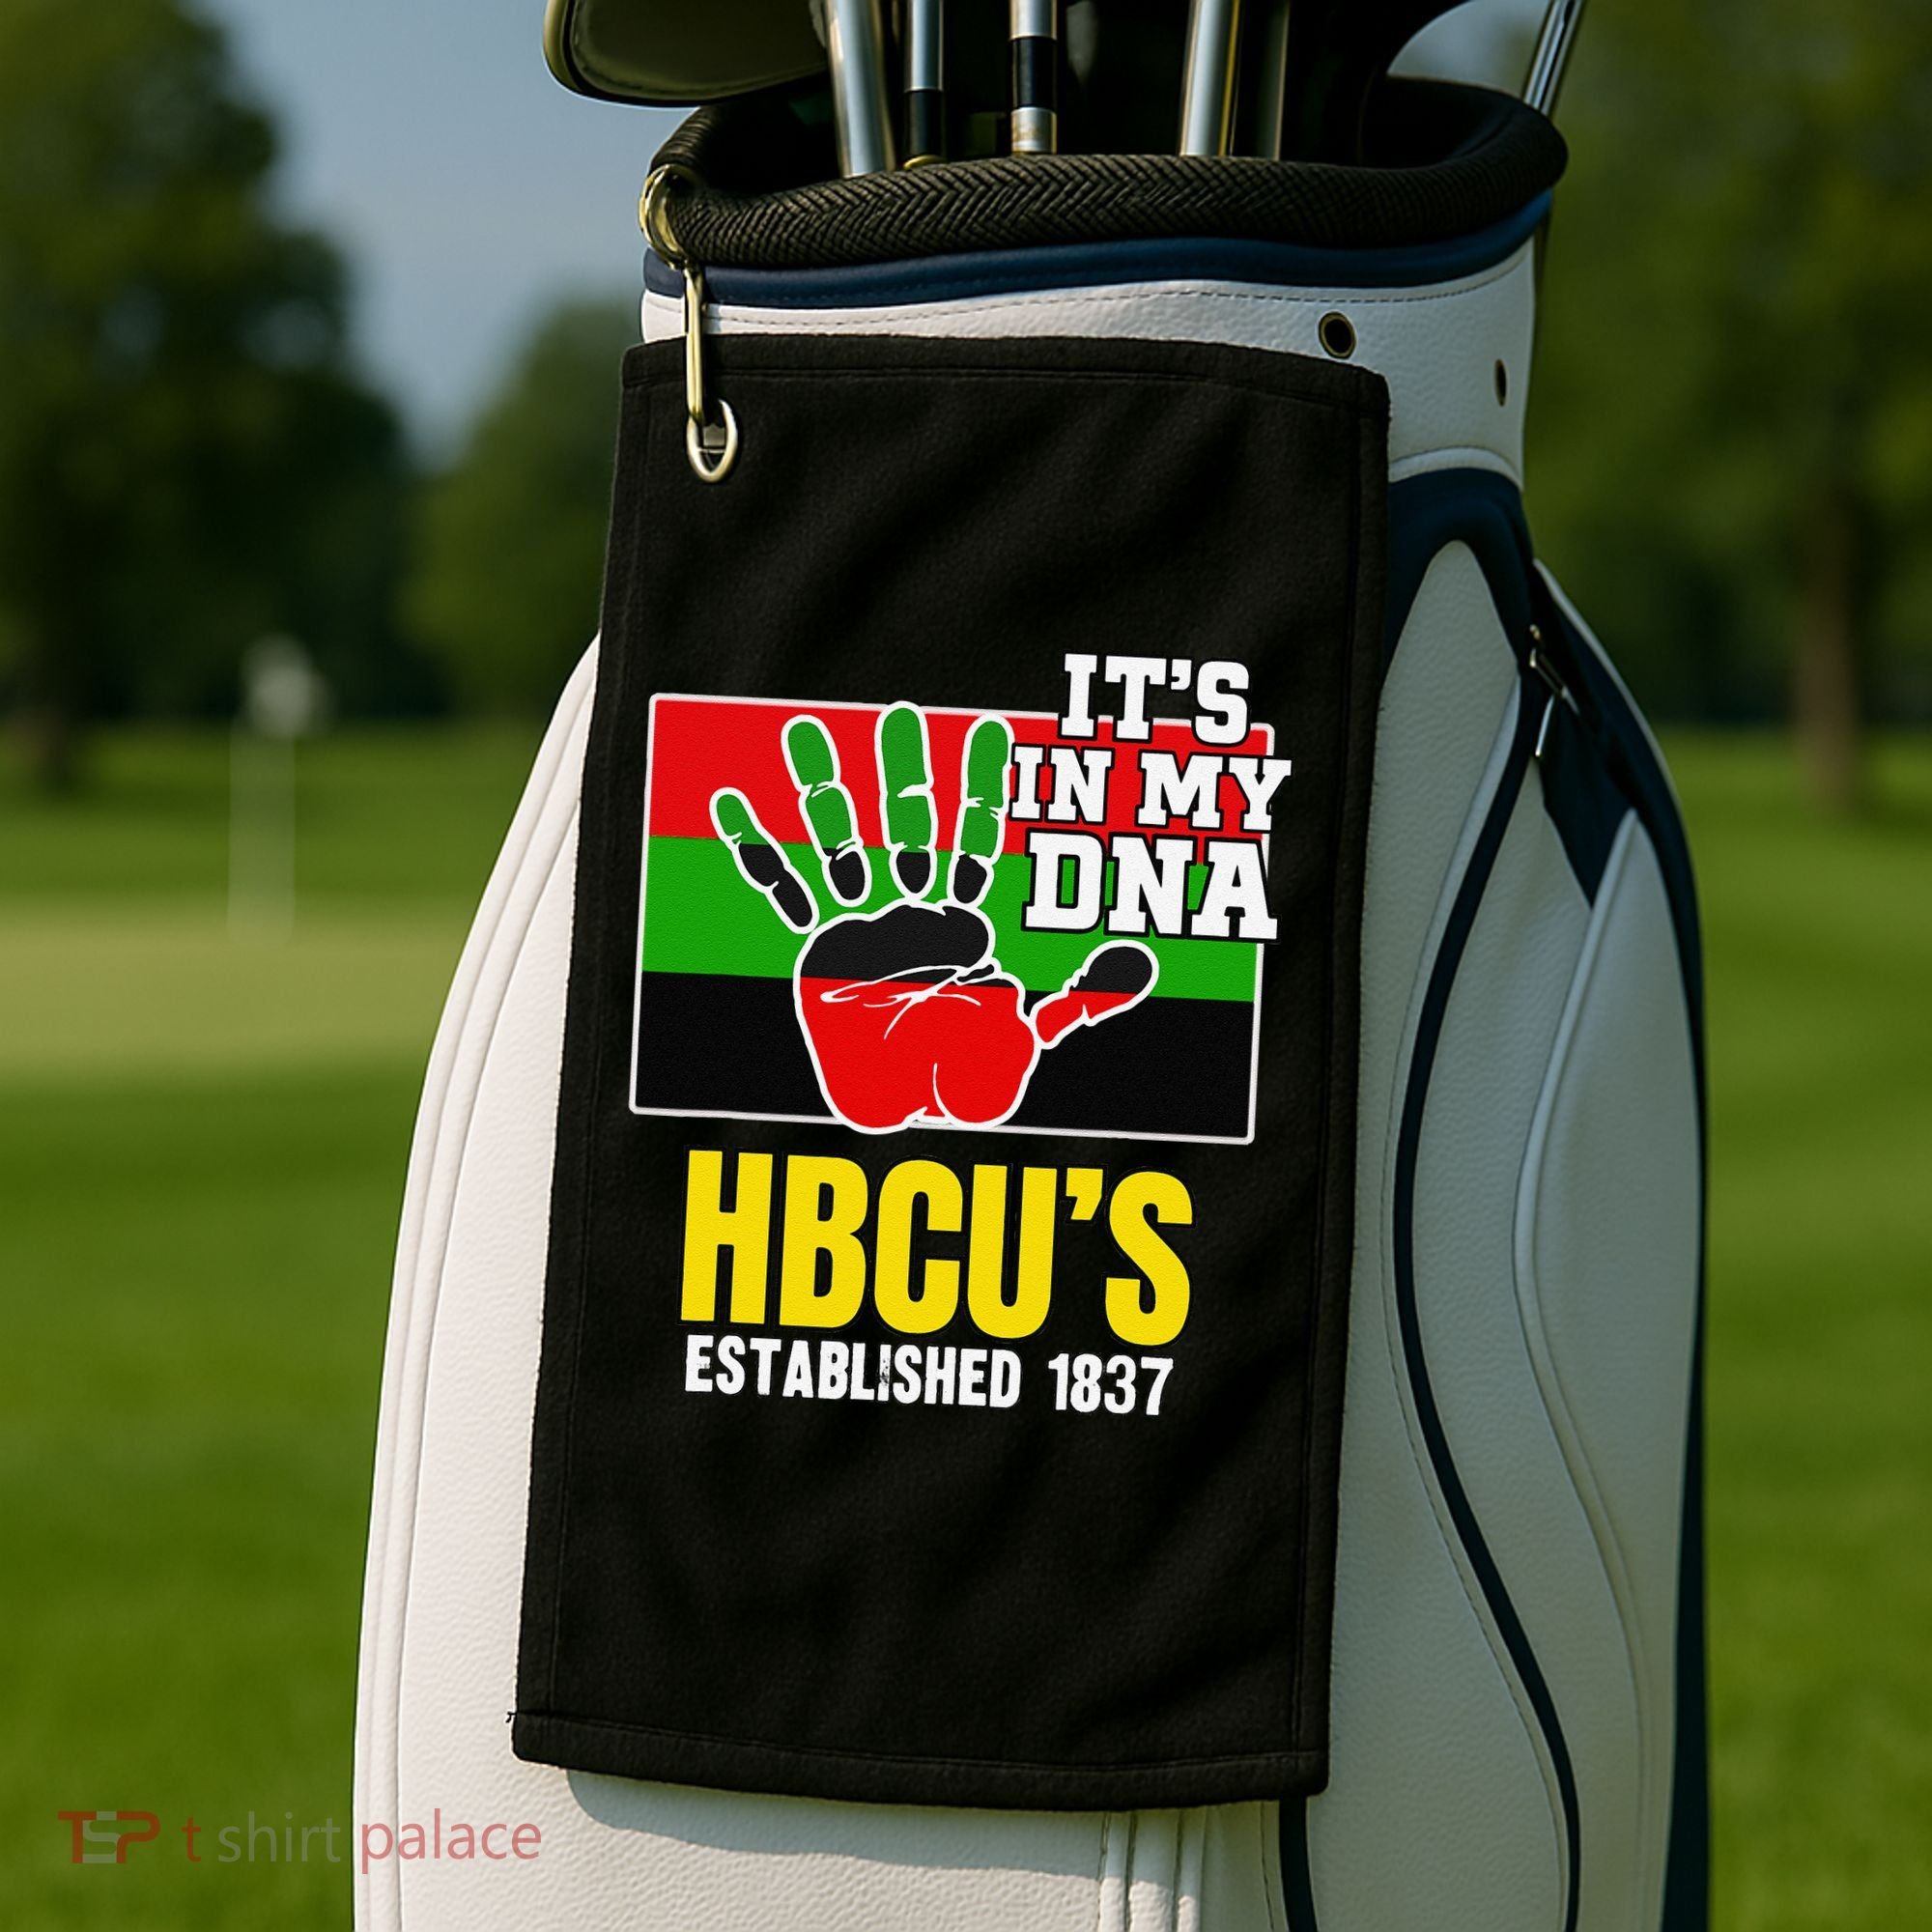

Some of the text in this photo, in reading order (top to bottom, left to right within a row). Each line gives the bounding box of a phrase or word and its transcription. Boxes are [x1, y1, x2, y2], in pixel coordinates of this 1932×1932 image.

[1061, 653, 1250, 745] IT'S
[1010, 745, 1293, 832] IN MY
[1024, 831, 1278, 940] DNA
[680, 1149, 1194, 1347] HBCU'S
[684, 1333, 1175, 1416] ESTABLISHED 1837
